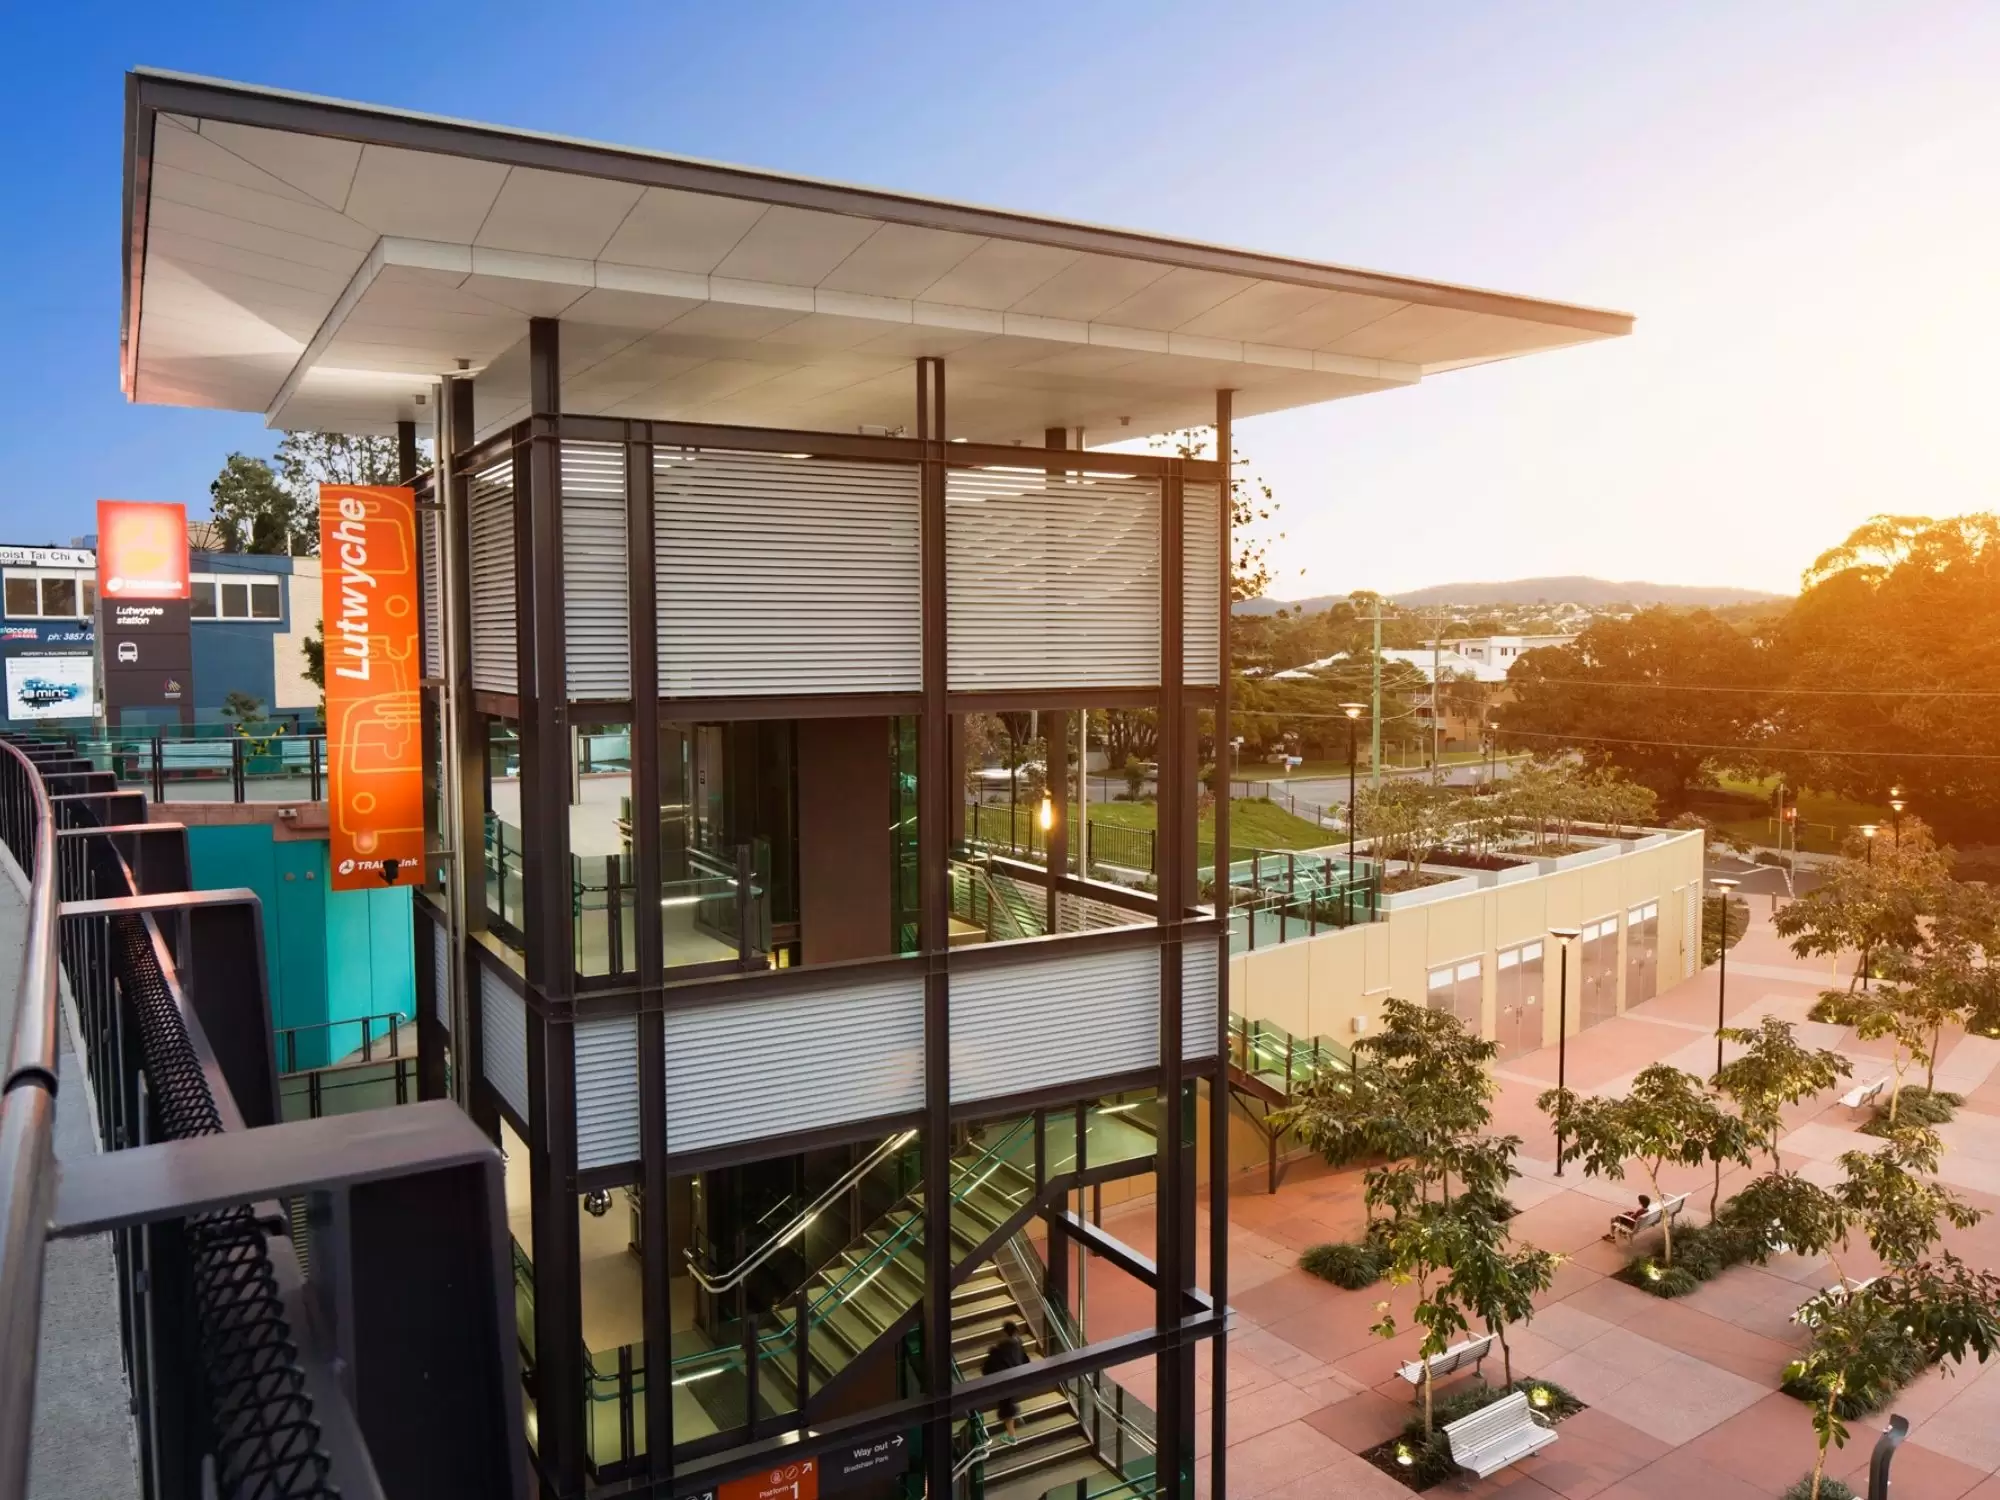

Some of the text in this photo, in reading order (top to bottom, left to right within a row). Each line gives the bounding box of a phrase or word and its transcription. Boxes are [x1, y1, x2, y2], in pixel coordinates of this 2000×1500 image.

[0, 550, 70, 560] oist Tai Chi
[332, 497, 377, 681] Lutwyche
[116, 605, 164, 617] Lutwyche
[116, 616, 150, 625] station
[47, 633, 61, 642] ph:
[63, 632, 84, 641] 3857
[853, 1441, 889, 1459] Way out
[875, 1455, 889, 1464] Park
[759, 1481, 799, 1500] Platform 1
